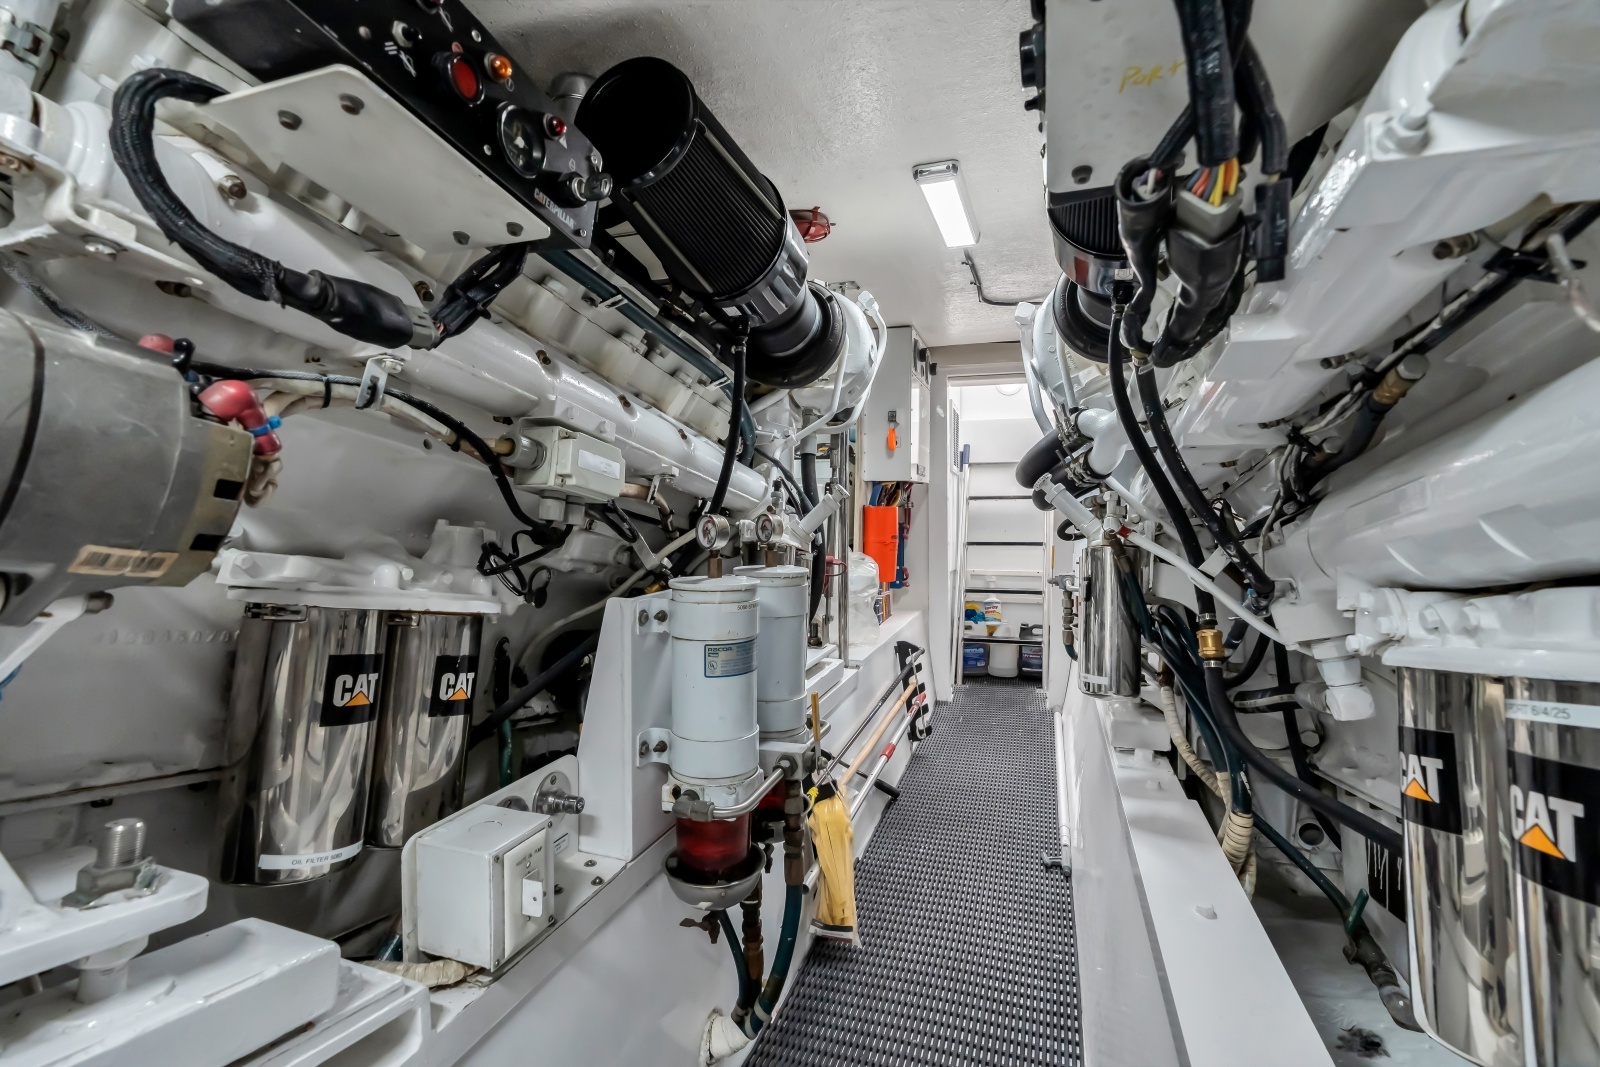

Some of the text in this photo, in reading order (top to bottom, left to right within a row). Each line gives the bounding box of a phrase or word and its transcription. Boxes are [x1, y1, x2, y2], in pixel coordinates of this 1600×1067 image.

[533, 188, 575, 229] CATERPILLAR
[332, 672, 379, 708] CAT
[438, 672, 475, 701] CAT
[1399, 750, 1444, 804] CAT
[1509, 784, 1585, 863] CAT
[305, 856, 329, 864] FILTER
